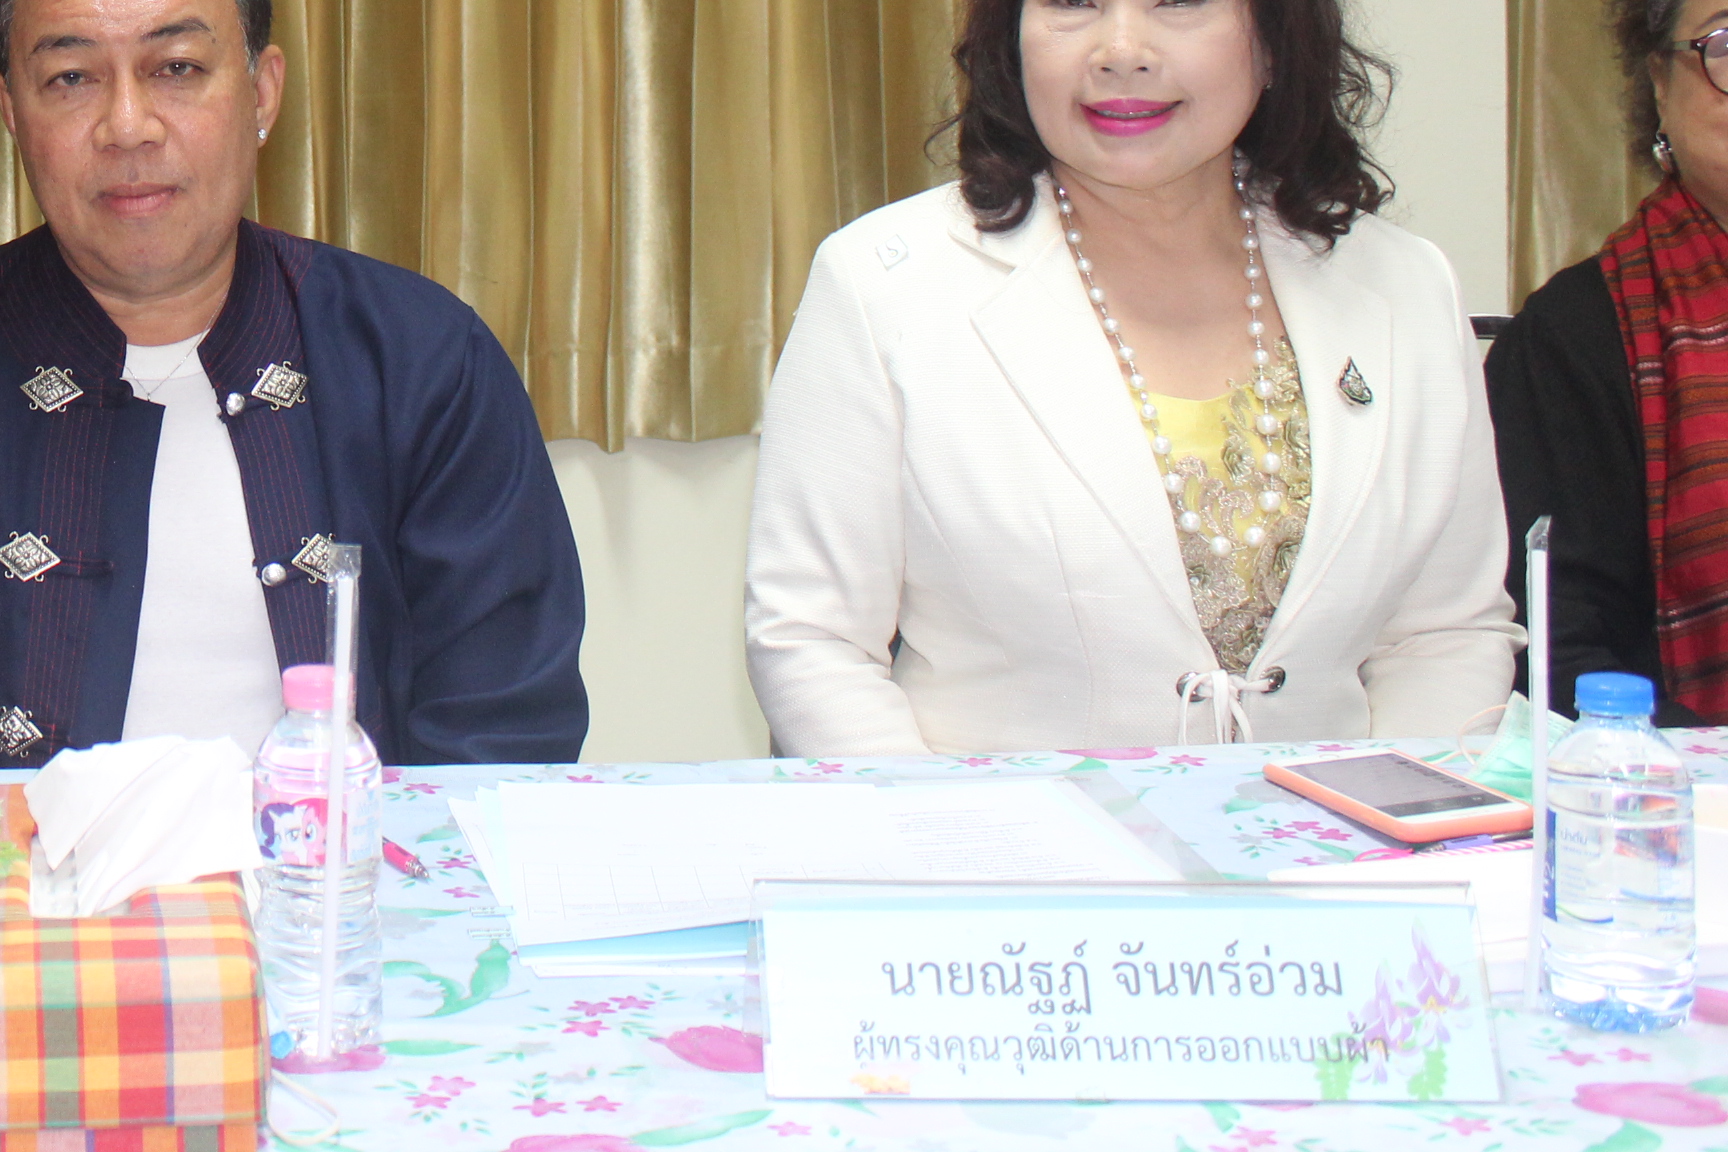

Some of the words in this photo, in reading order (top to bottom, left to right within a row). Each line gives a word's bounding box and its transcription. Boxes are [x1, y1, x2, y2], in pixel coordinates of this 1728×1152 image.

[882, 939, 1093, 1016] นายณัฐฏ์
[1112, 939, 1344, 997] จันทร์อ่วม
